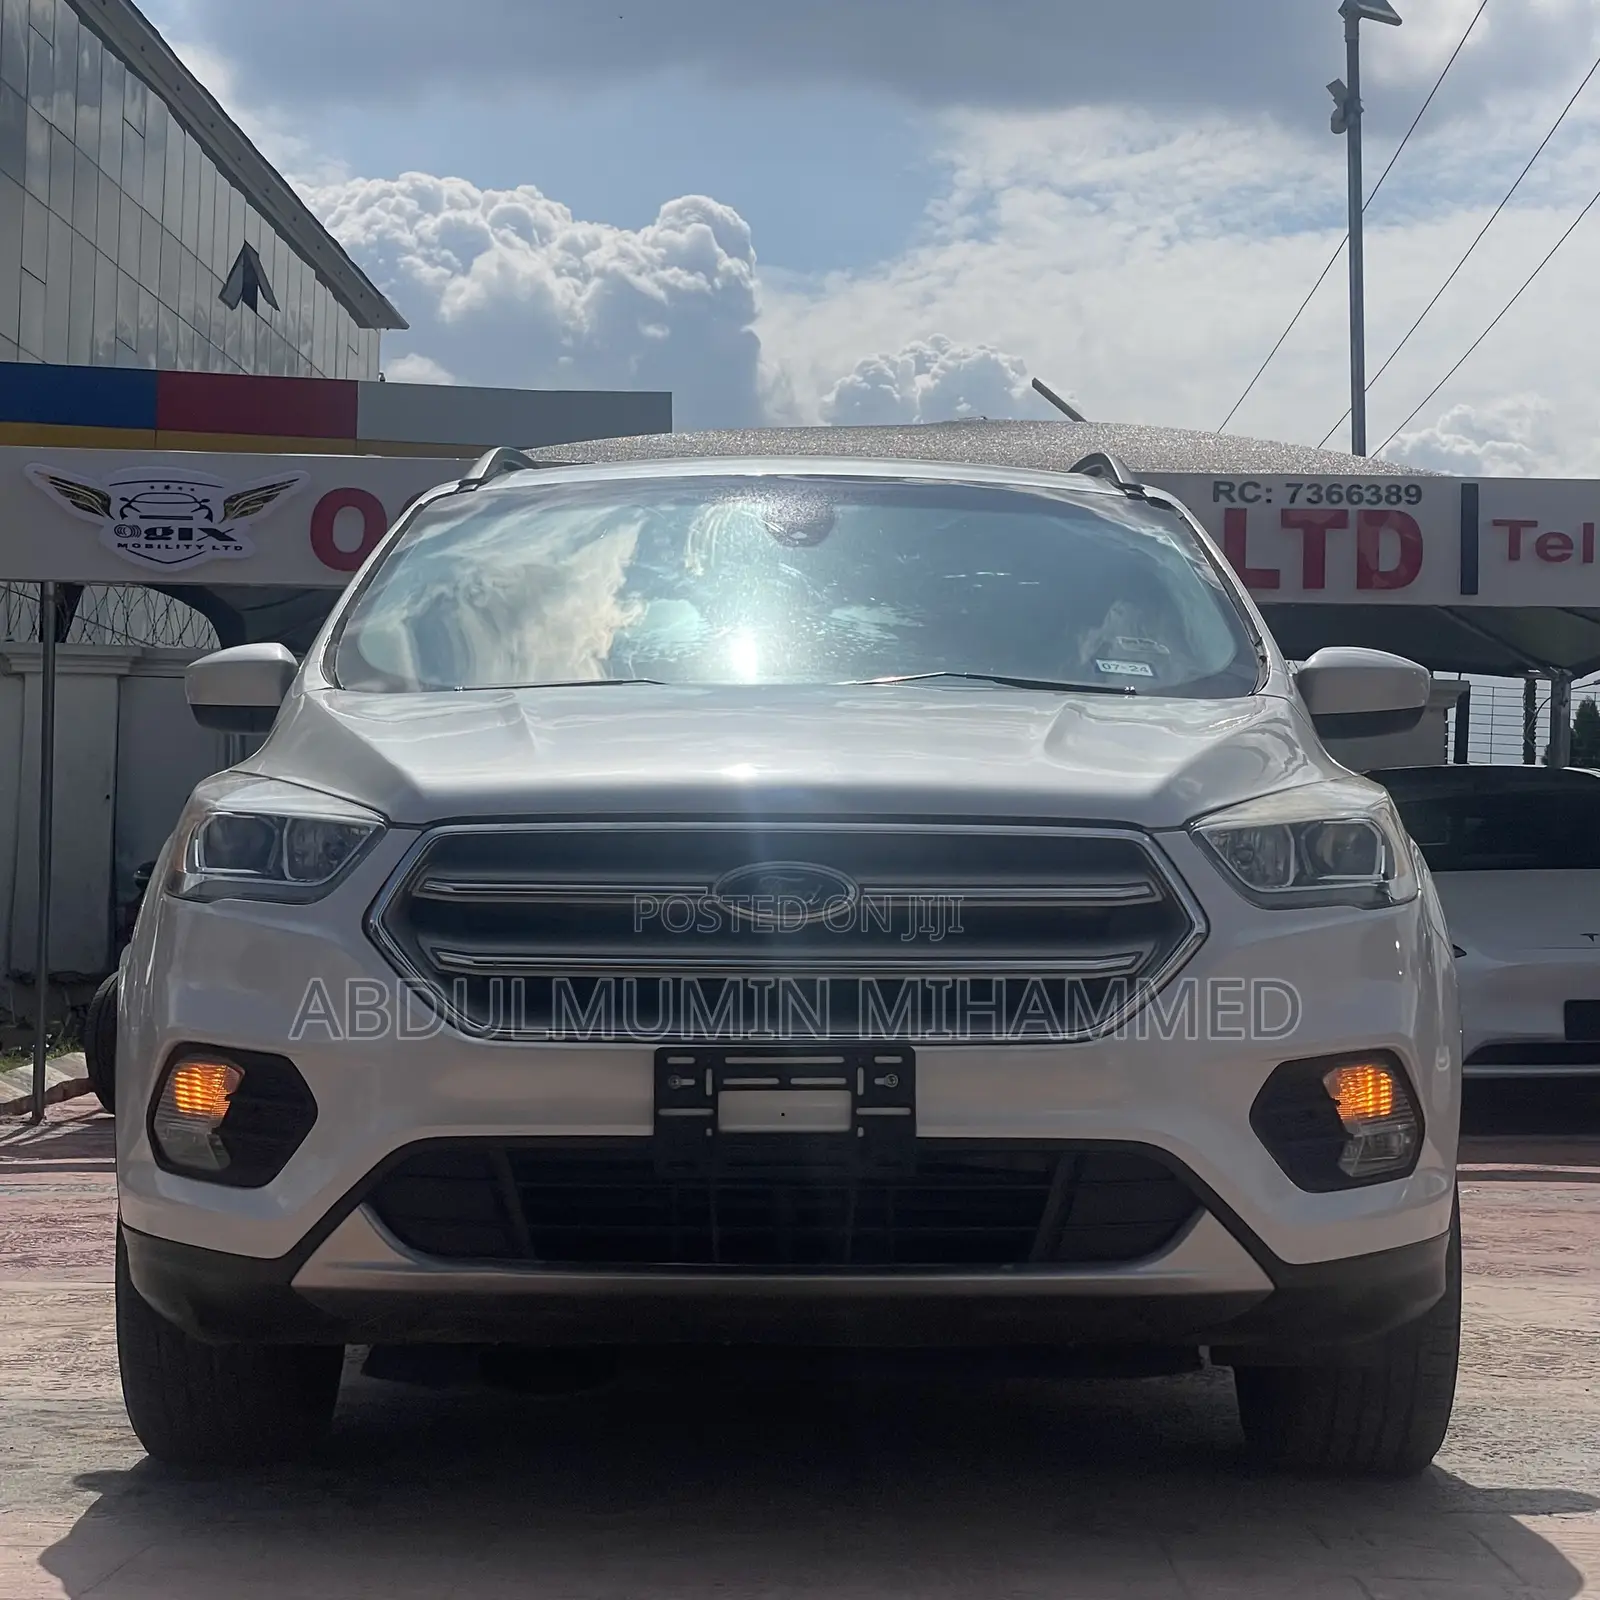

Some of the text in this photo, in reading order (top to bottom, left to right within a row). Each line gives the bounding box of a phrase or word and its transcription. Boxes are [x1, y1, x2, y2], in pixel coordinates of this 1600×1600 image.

[1212, 481, 1423, 505] RC: 7366389
[117, 542, 205, 550] MOBILITY
[310, 487, 426, 572] O
[1224, 508, 1424, 590] LTD
[1492, 519, 1595, 564] Tel
